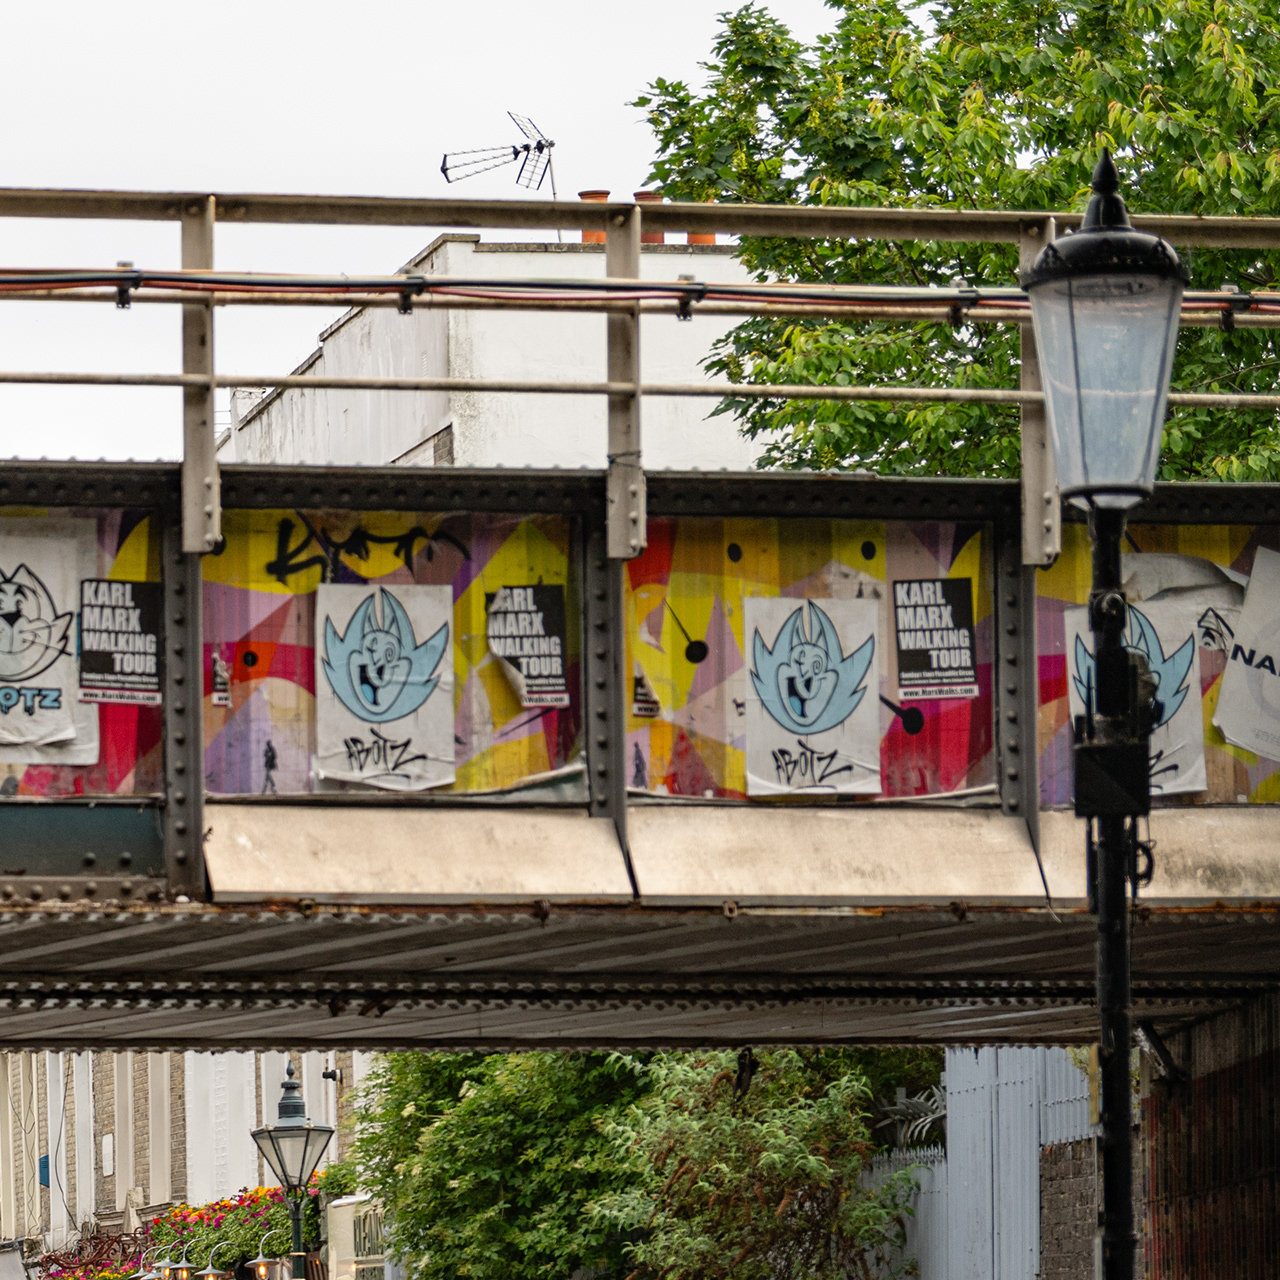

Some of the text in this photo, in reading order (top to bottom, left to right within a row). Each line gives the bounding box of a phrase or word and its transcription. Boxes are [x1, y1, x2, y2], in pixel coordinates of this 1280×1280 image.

[82, 581, 135, 607] KARL
[502, 587, 537, 611] ARL
[896, 581, 946, 606] KARL
[82, 606, 142, 632] MARX
[489, 612, 545, 636] MARX
[896, 604, 954, 630] MARX
[82, 630, 157, 654] WALKING
[489, 636, 561, 657] WALKING
[898, 628, 970, 650] WALKING
[112, 653, 157, 674] TOUR
[518, 656, 562, 676] TOUR
[928, 648, 971, 669] TOUR
[1230, 643, 1280, 678] NA
[344, 728, 427, 773] ABOTZ
[772, 739, 853, 784] ABOTZ
